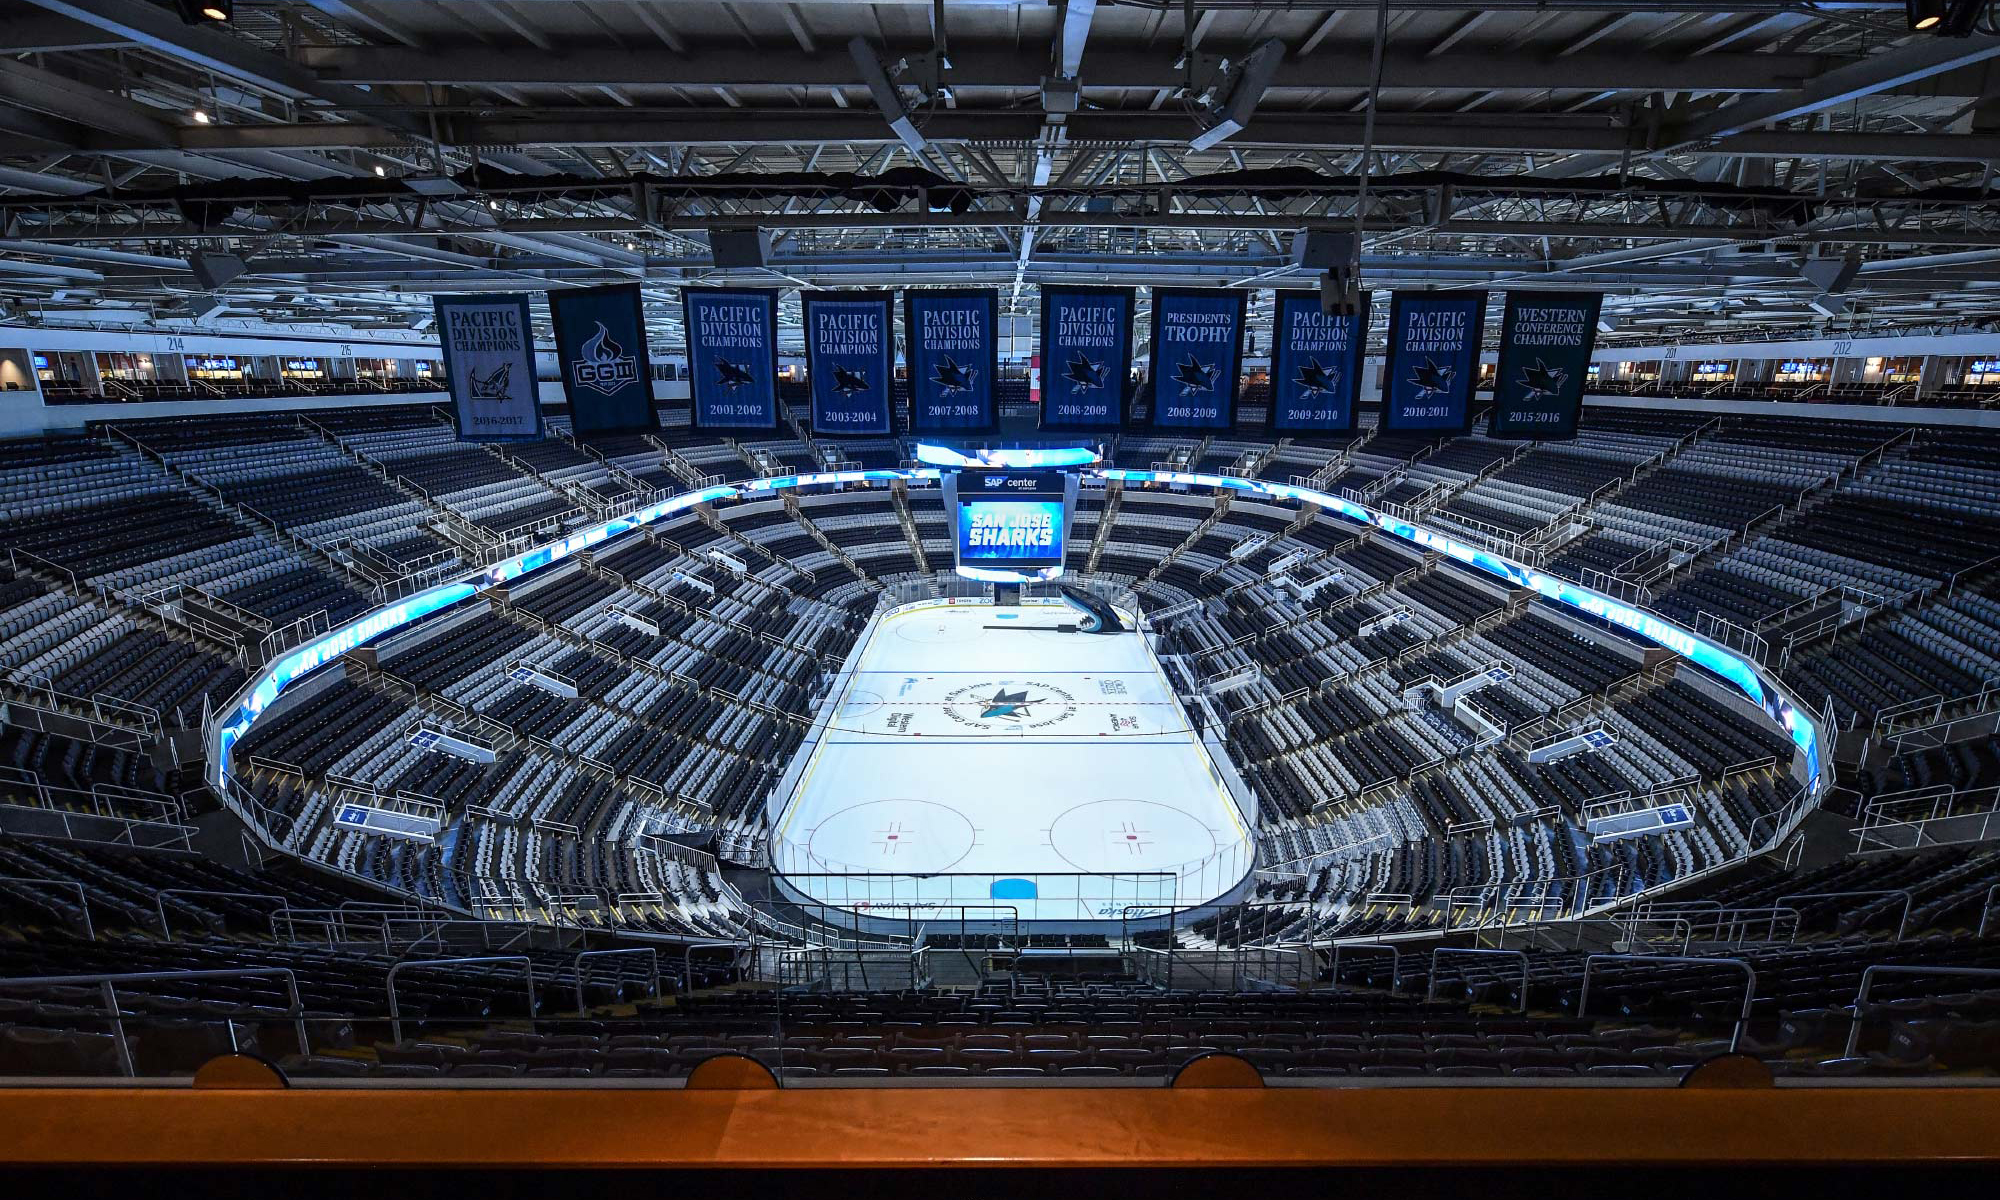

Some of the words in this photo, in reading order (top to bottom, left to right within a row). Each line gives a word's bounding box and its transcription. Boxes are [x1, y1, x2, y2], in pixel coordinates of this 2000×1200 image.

[450, 311, 516, 327] PACIFIC
[699, 306, 761, 324] PACIFIC
[819, 313, 878, 330] PACIFIC
[923, 310, 980, 326] PACIFIC
[1059, 307, 1116, 323] PACIFIC
[1167, 312, 1231, 325] PRESIDENTS
[1293, 312, 1350, 327] PACIFIC
[1408, 312, 1466, 327] PACIFIC
[1516, 308, 1586, 323] WESTERN
[452, 326, 519, 341] DIVISION
[701, 322, 762, 337] DIVISION
[923, 325, 980, 340] DIVISION
[1059, 322, 1115, 337] DIVISION
[1165, 325, 1232, 343] TROPHY
[1292, 327, 1348, 341] DIVISION
[1407, 327, 1464, 341] DIVISION
[1515, 322, 1584, 334] CONFERENCE
[702, 336, 762, 348] CHAMPIONS
[819, 330, 878, 343] DIVISION
[1058, 335, 1114, 347] CHAMPIONS
[1513, 334, 1582, 346] CHAMPIONS
[167, 337, 184, 352] 214
[340, 344, 352, 355] 215
[454, 340, 521, 353] CHAMPIONS
[819, 343, 878, 355] CHAMPIONS
[924, 338, 980, 350] CHAMPIONS
[1290, 340, 1347, 351] CHAMPIONS
[1405, 340, 1462, 352] CHAMPIONS
[1832, 342, 1852, 356] 202
[1666, 347, 1677, 359] 201
[710, 404, 762, 416] 2001-2002
[928, 405, 978, 416] 2007-2008
[1058, 404, 1107, 416] 2008-2009
[1167, 407, 1217, 418] 2008-2009
[1288, 409, 1338, 420] 2009-2010
[1403, 406, 1449, 417] 2010-2011
[1509, 411, 1560, 422] 2015-2016
[473, 416, 523, 425] 2016-2017
[825, 411, 878, 423] 2003-2004
[985, 478, 1002, 486] SAP
[1007, 478, 1036, 486] center
[972, 513, 1005, 527] SAN
[1009, 513, 1051, 527] JOSE
[969, 527, 1053, 545] SHARKS
[358, 605, 405, 641] SHARKS
[1645, 618, 1696, 655] SHARKS
[887, 713, 902, 727] Digital
[898, 713, 914, 732] Western
[964, 722, 991, 730] SAP
[1099, 908, 1158, 918] Alaska
